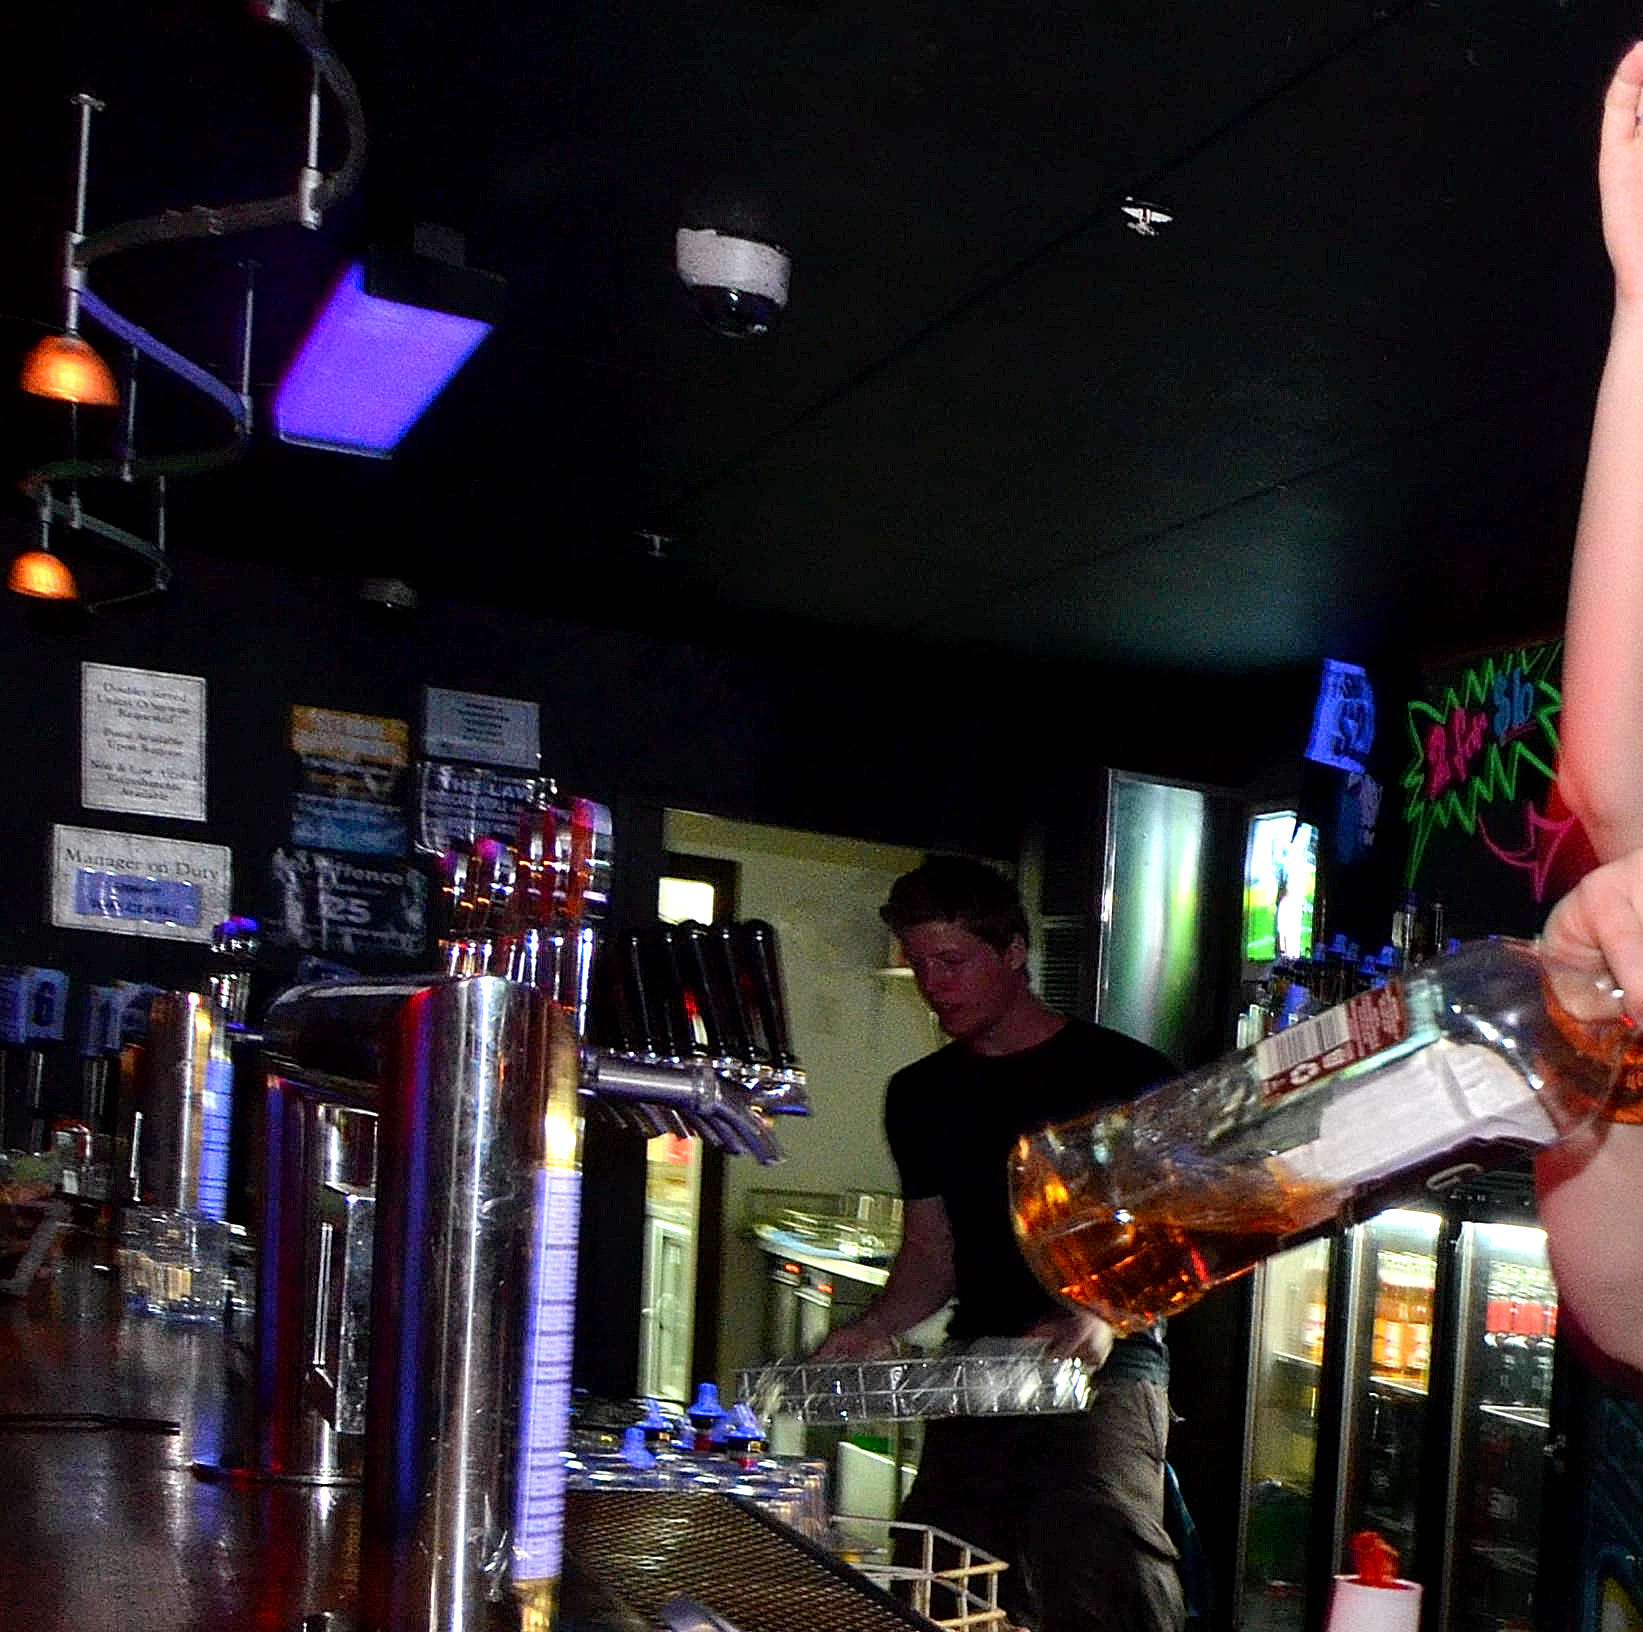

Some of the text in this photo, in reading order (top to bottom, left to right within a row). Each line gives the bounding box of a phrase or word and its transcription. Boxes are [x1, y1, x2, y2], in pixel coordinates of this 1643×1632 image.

[65, 848, 218, 880] Manager on Duty
